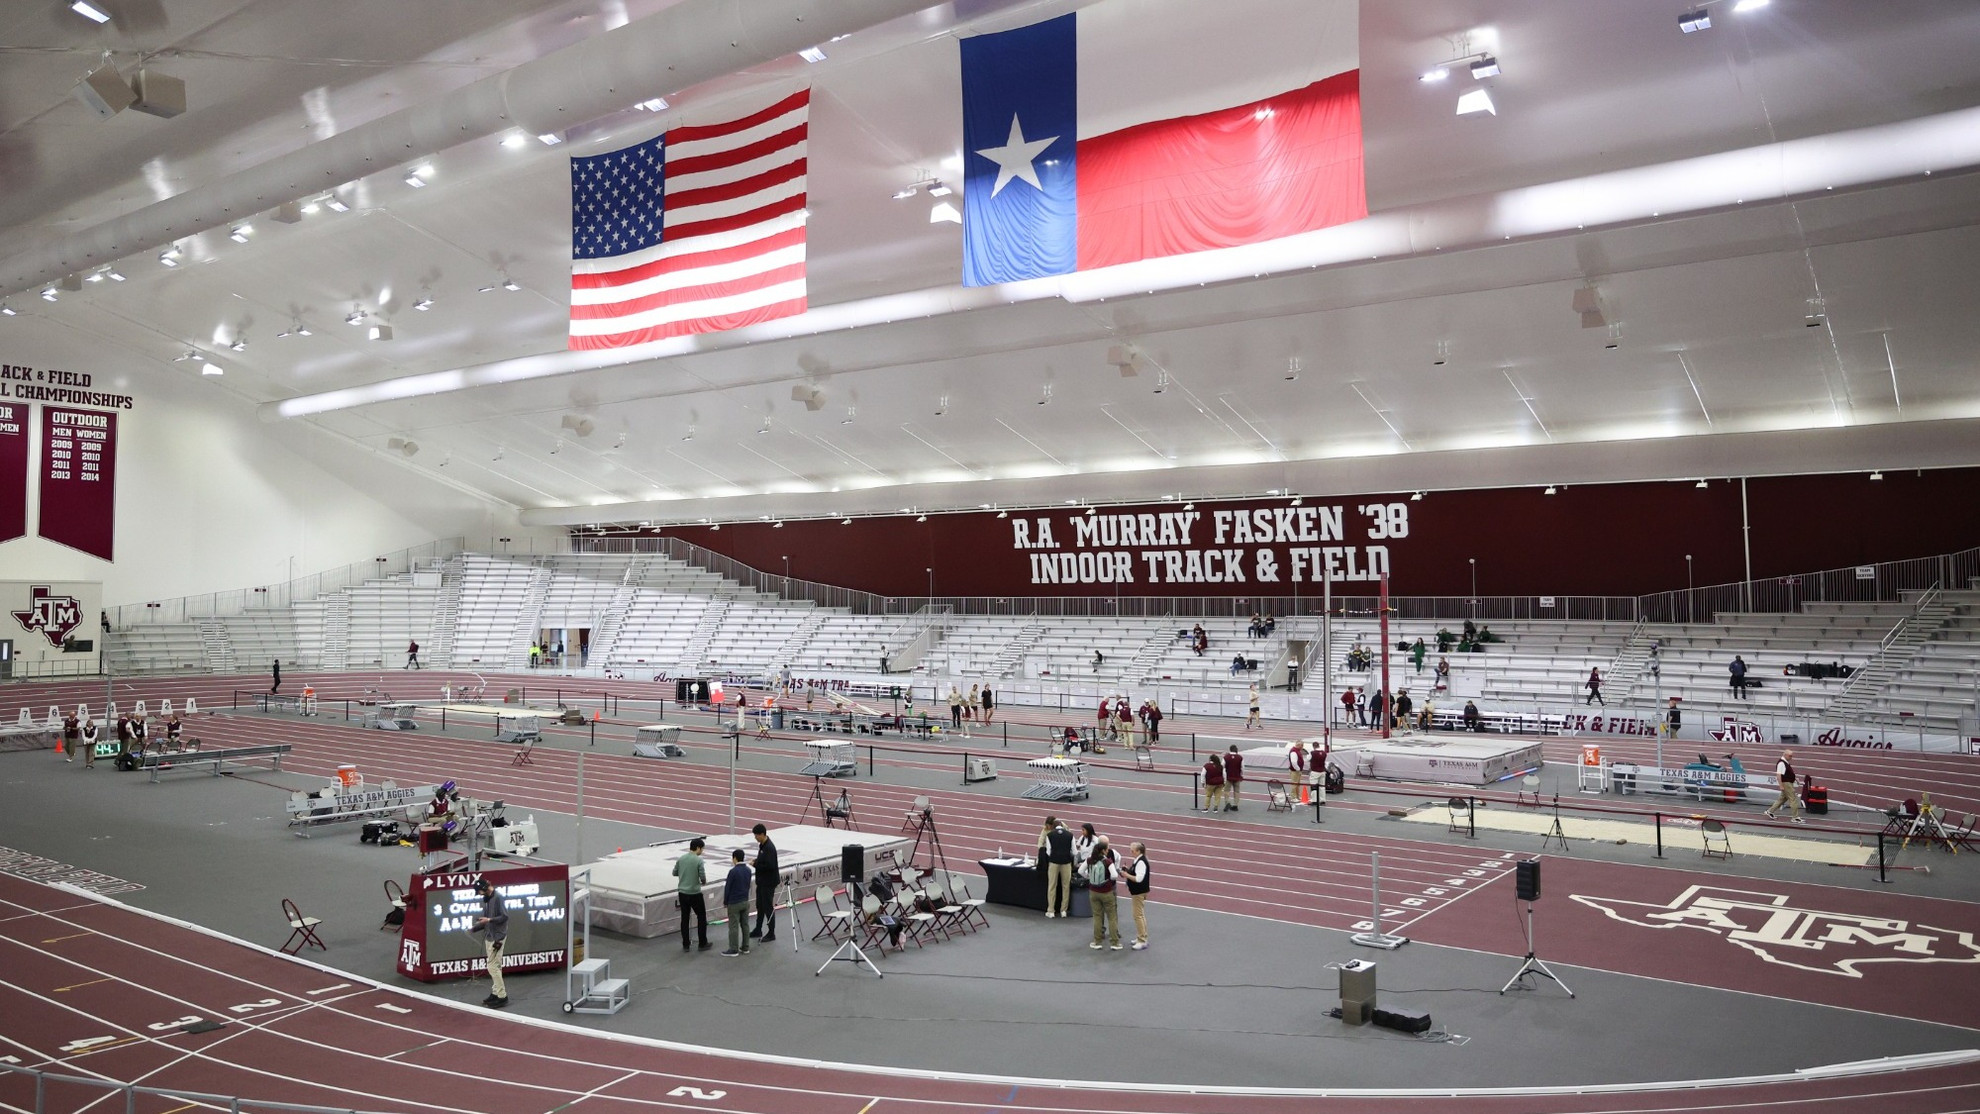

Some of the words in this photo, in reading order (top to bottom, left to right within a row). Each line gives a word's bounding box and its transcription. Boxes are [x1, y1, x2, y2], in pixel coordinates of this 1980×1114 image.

[37, 371, 44, 380] &
[48, 370, 91, 387] FIELD
[16, 384, 133, 409] CHAMPIONSHIPS
[52, 411, 107, 428] OUTDOOR
[52, 428, 72, 437] MEN
[76, 429, 106, 440] WOMEN
[51, 440, 73, 449] 2009
[81, 442, 102, 451] 2009
[52, 450, 71, 459] 2010
[81, 452, 101, 461] 2010
[52, 460, 70, 469] 2011
[82, 462, 99, 471] 2011
[51, 471, 71, 480] 2013
[81, 472, 99, 481] 2014
[1012, 518, 1060, 549] R.A.
[1213, 505, 1344, 544] FASKEN
[1358, 503, 1409, 539] '38
[1030, 551, 1134, 584] INDOOR
[1142, 549, 1246, 582] TRACK
[1255, 548, 1280, 582] &
[1289, 545, 1390, 582] FIELD
[51, 708, 58, 717] 6
[80, 706, 87, 714] 5
[138, 703, 144, 711] 3
[164, 702, 170, 710] 2
[22, 710, 29, 718] 7
[1591, 716, 1603, 732] &
[1660, 768, 1689, 778] TEXAS
[1692, 770, 1711, 780] A&M
[1714, 772, 1747, 782] AGGIES
[335, 794, 364, 806] TEXAS
[366, 791, 384, 803] A&M
[387, 788, 415, 800] AGGIES
[436, 872, 483, 888] LYNX
[449, 902, 483, 915] OVAL
[528, 907, 565, 922] TAMU
[1379, 908, 1406, 917] 7
[431, 959, 469, 975] TEXAS
[228, 998, 282, 1013] 2
[665, 1085, 727, 1100] 2
